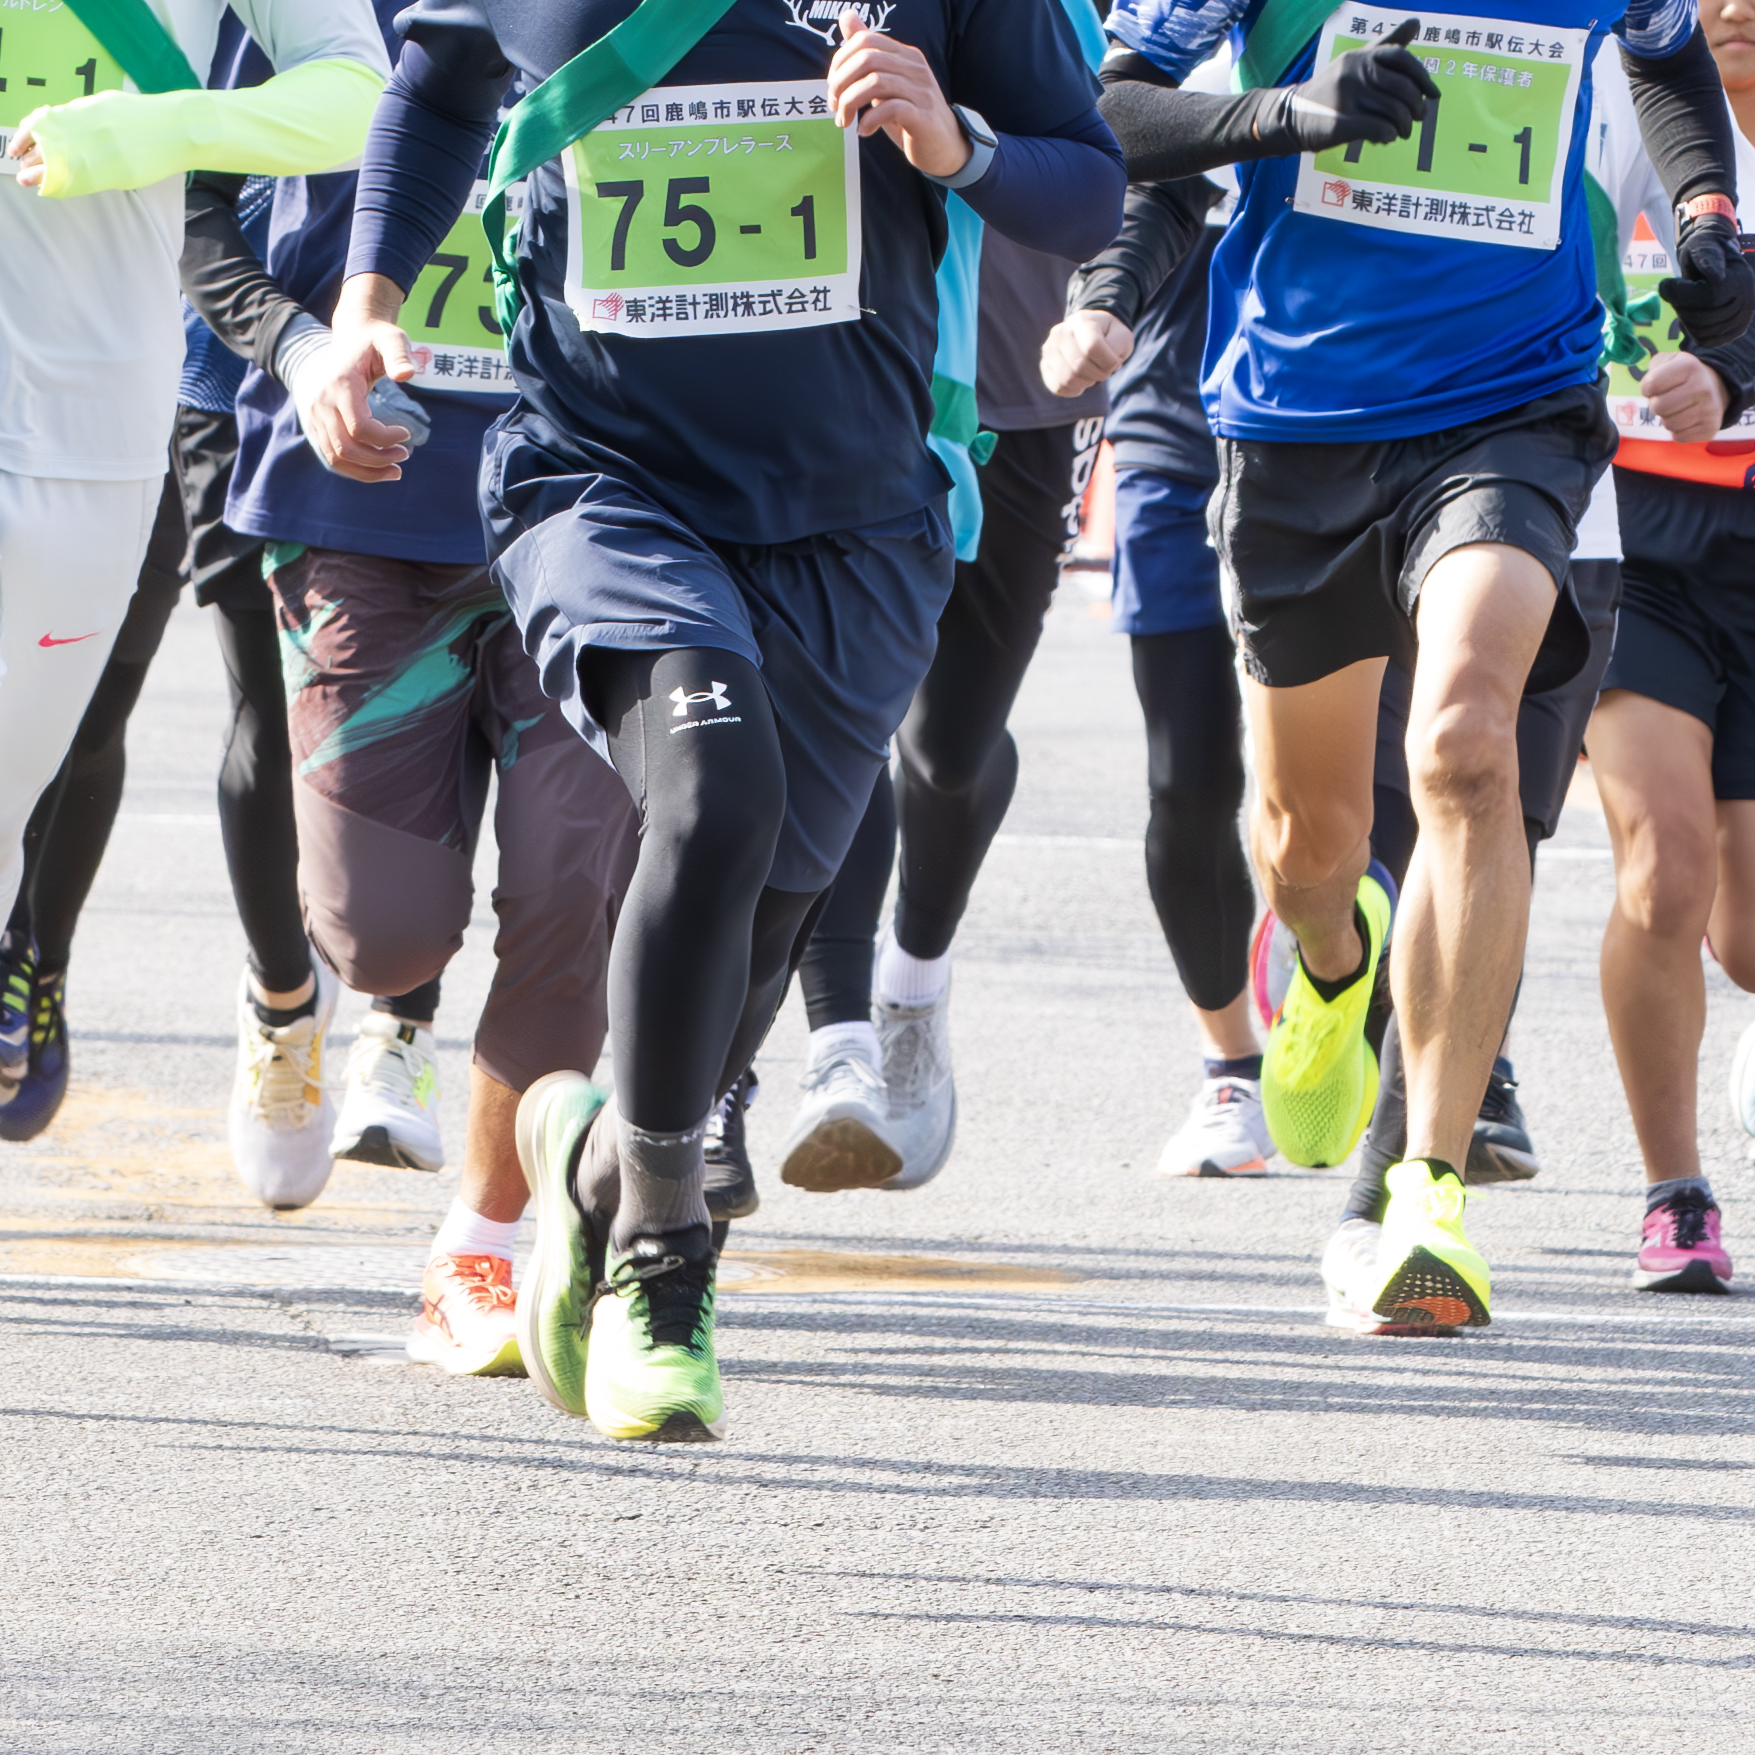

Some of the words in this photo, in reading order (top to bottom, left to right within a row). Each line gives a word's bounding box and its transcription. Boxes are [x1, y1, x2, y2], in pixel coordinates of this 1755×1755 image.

[1349, 16, 1565, 59] 第4鹿嶋市駅伝大会
[1419, 56, 1534, 89] 園2年保護者
[1351, 189, 1537, 236] 東洋計測株式会社
[624, 286, 833, 324] 東洋計測株式会社
